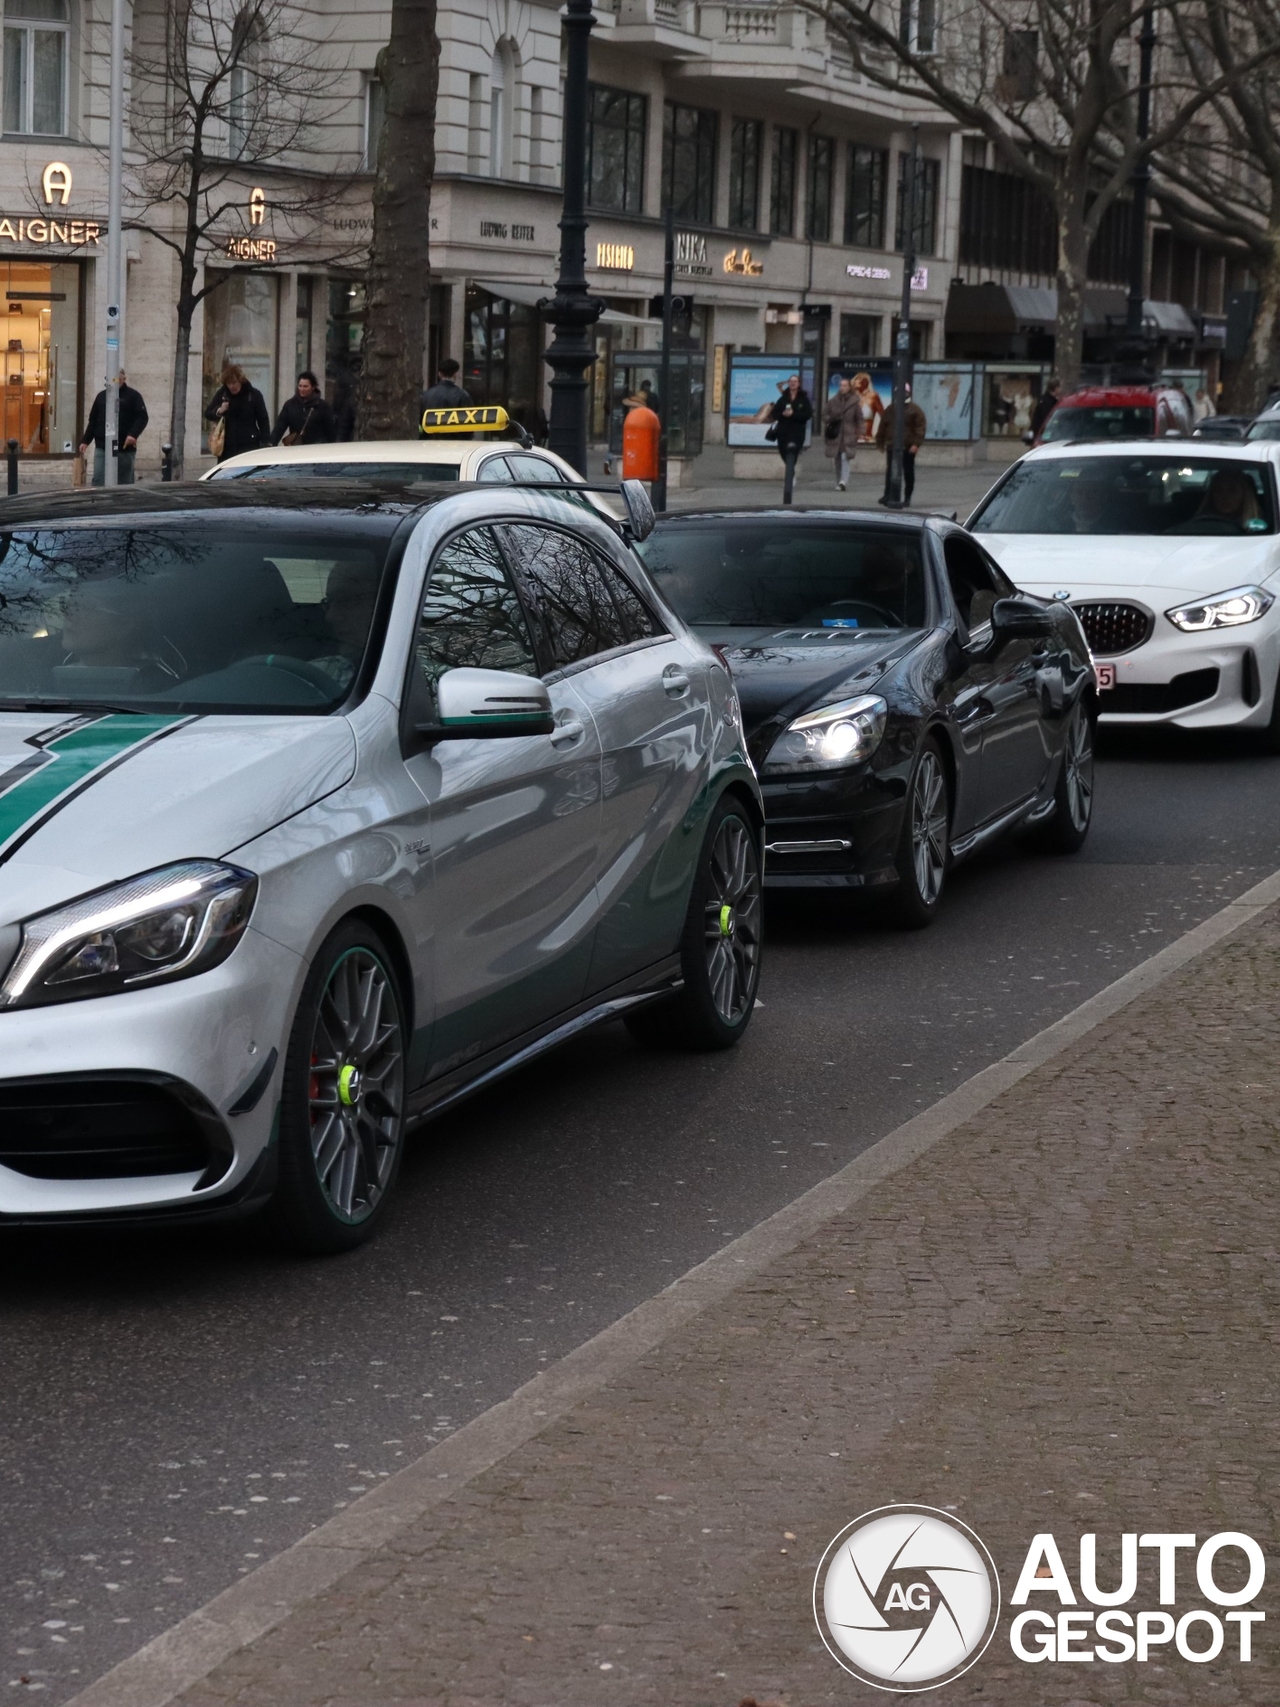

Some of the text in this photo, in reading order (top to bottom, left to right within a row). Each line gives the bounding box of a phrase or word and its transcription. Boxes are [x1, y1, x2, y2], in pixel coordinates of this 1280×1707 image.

[480, 220, 535, 241] LUDWIG REITER
[227, 237, 276, 261] AIGNER
[434, 409, 488, 425] TAXI
